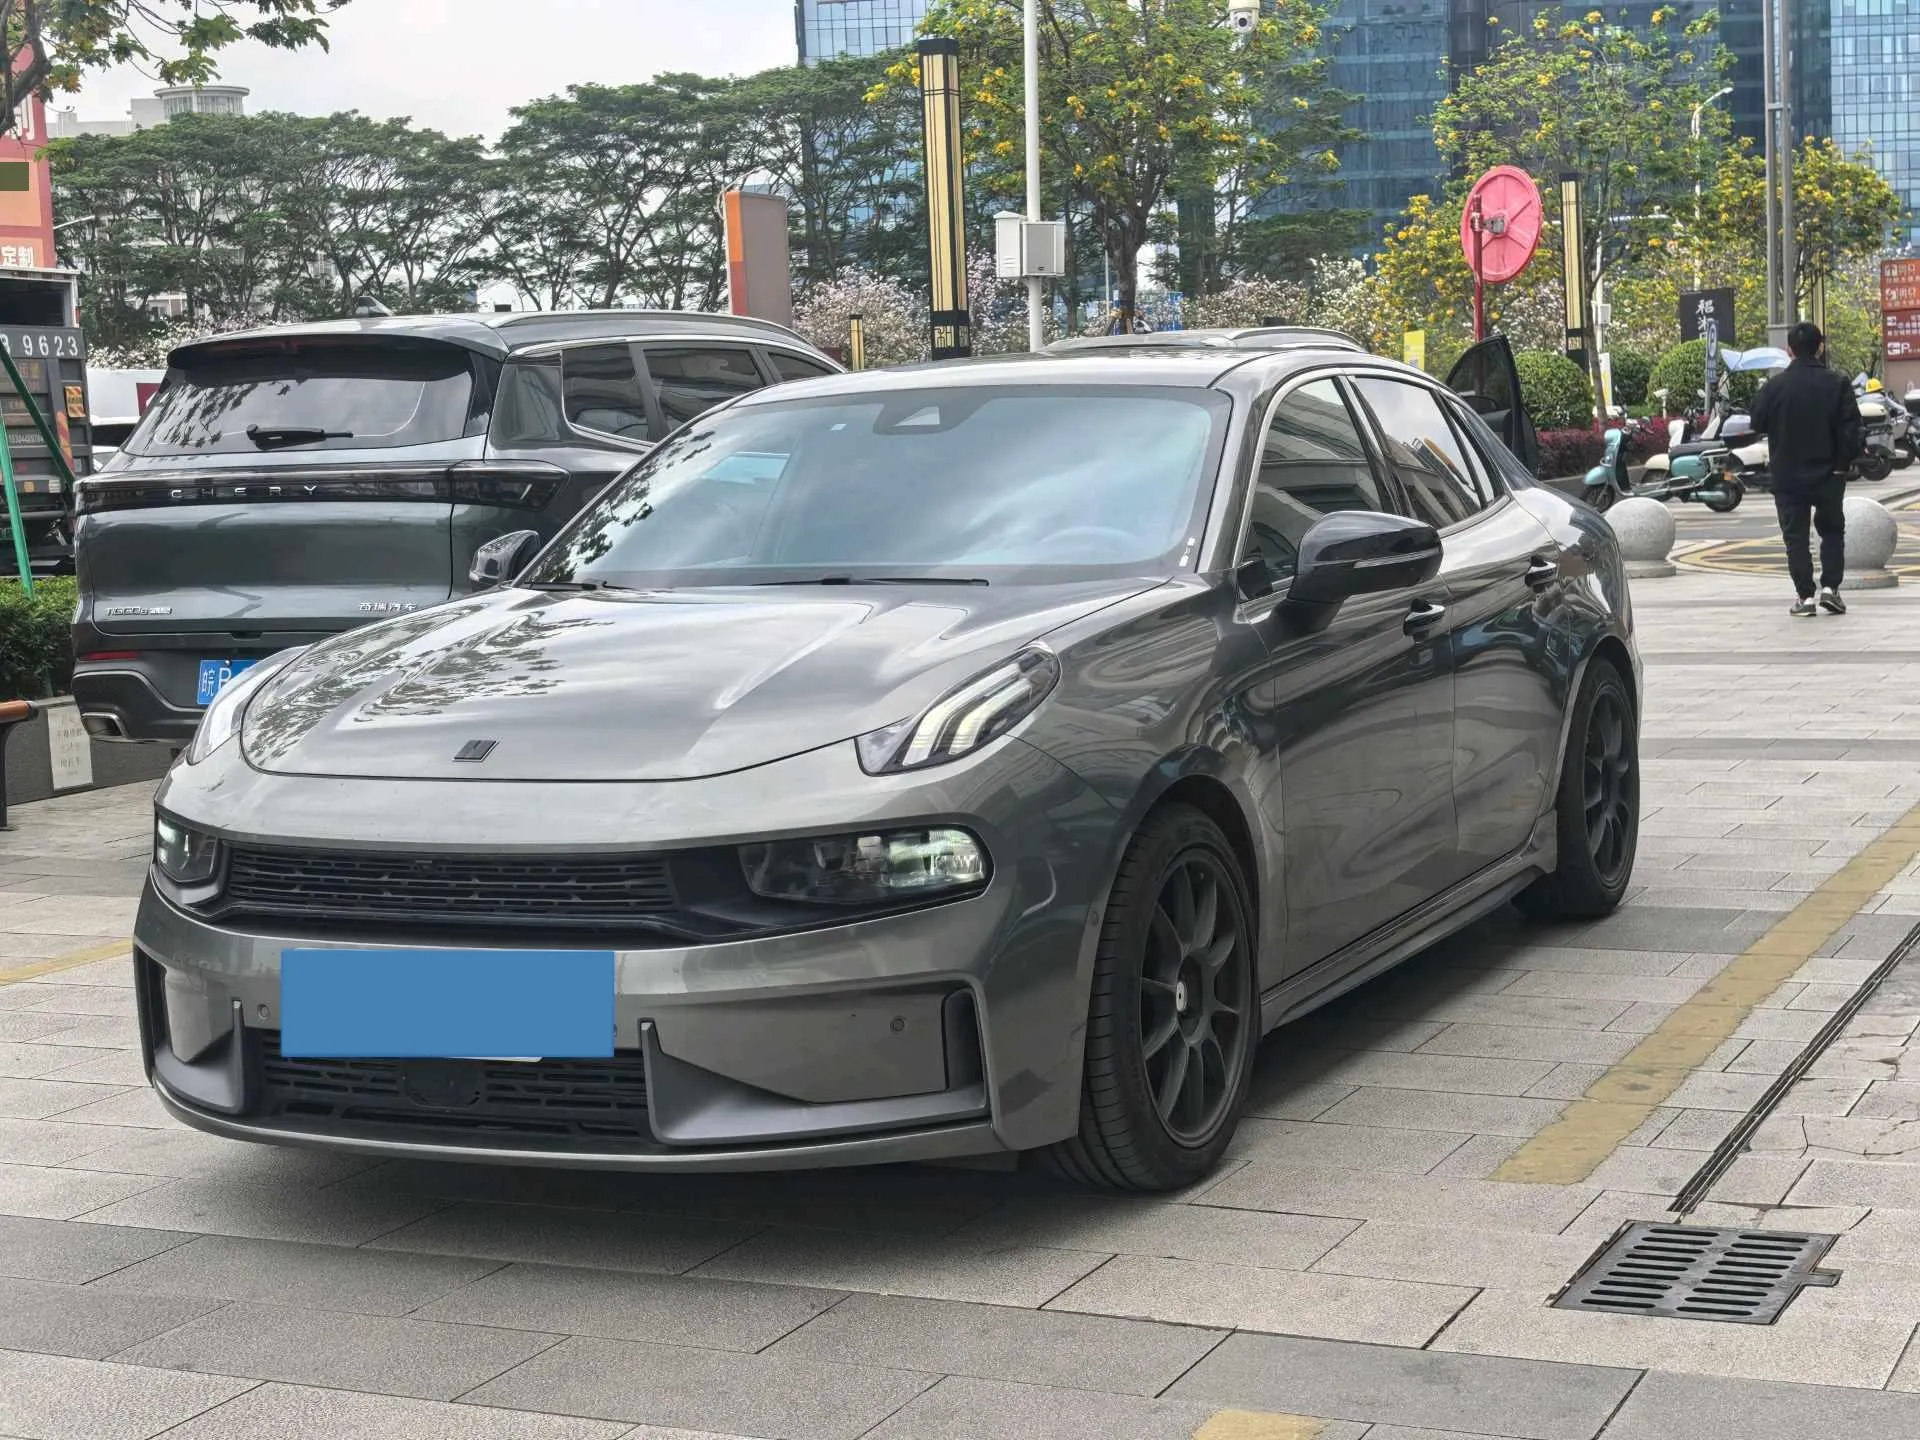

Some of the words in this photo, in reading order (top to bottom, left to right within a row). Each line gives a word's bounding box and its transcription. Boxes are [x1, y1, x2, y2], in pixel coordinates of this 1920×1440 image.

[1, 245, 34, 267] 定制
[171, 485, 317, 498] CHERY
[359, 601, 416, 612] 奇瑞汽车
